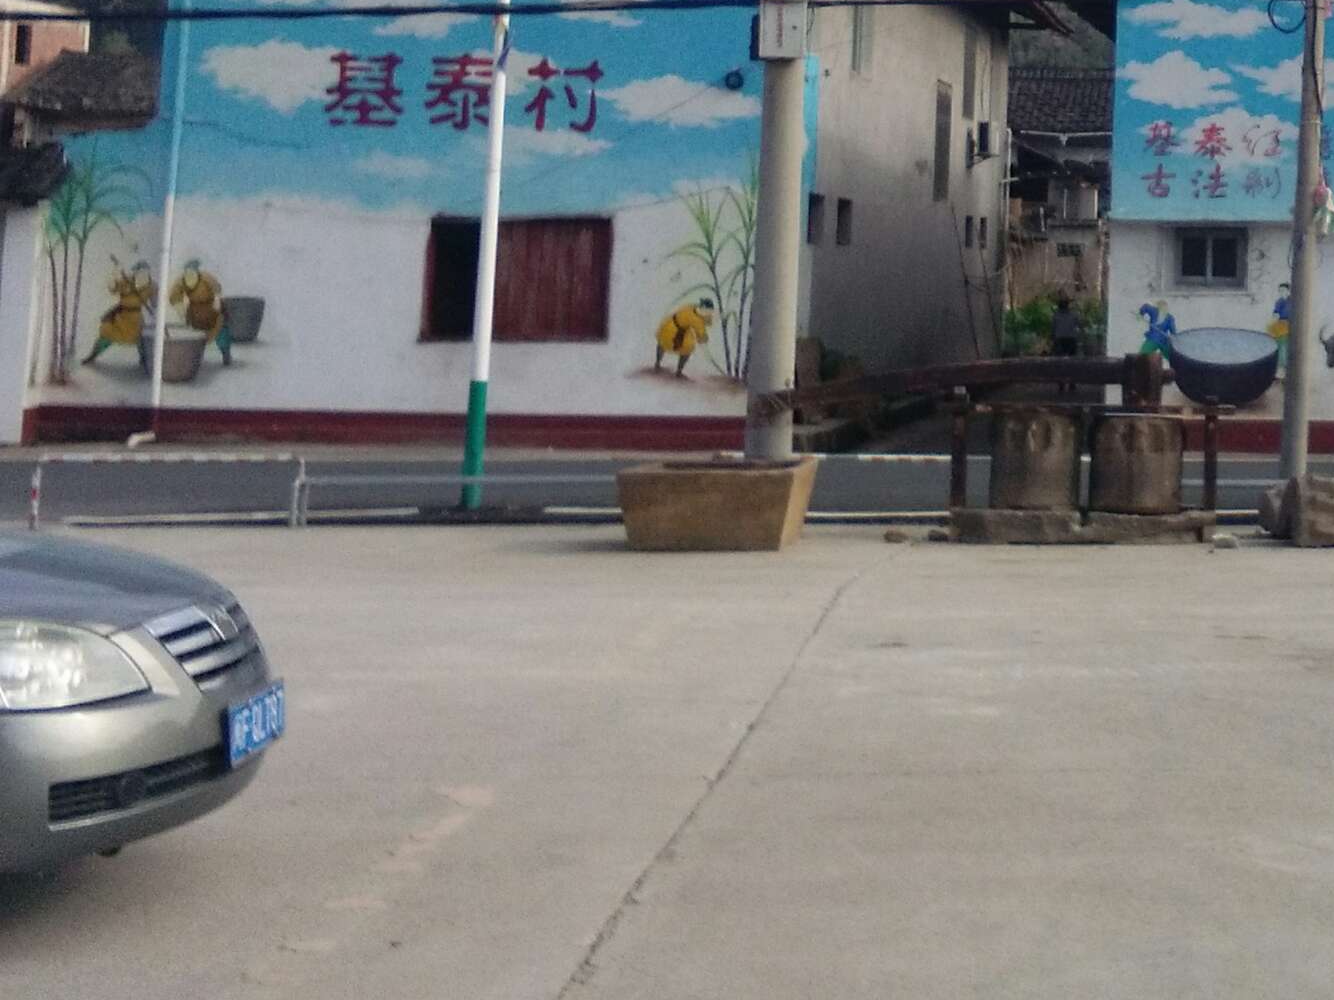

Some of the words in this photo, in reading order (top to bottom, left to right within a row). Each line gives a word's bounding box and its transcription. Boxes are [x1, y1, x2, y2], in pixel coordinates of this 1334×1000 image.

[324, 51, 604, 133] 基泰村
[1143, 119, 1334, 161] 基泰红
[1140, 162, 1332, 199] 古法制
